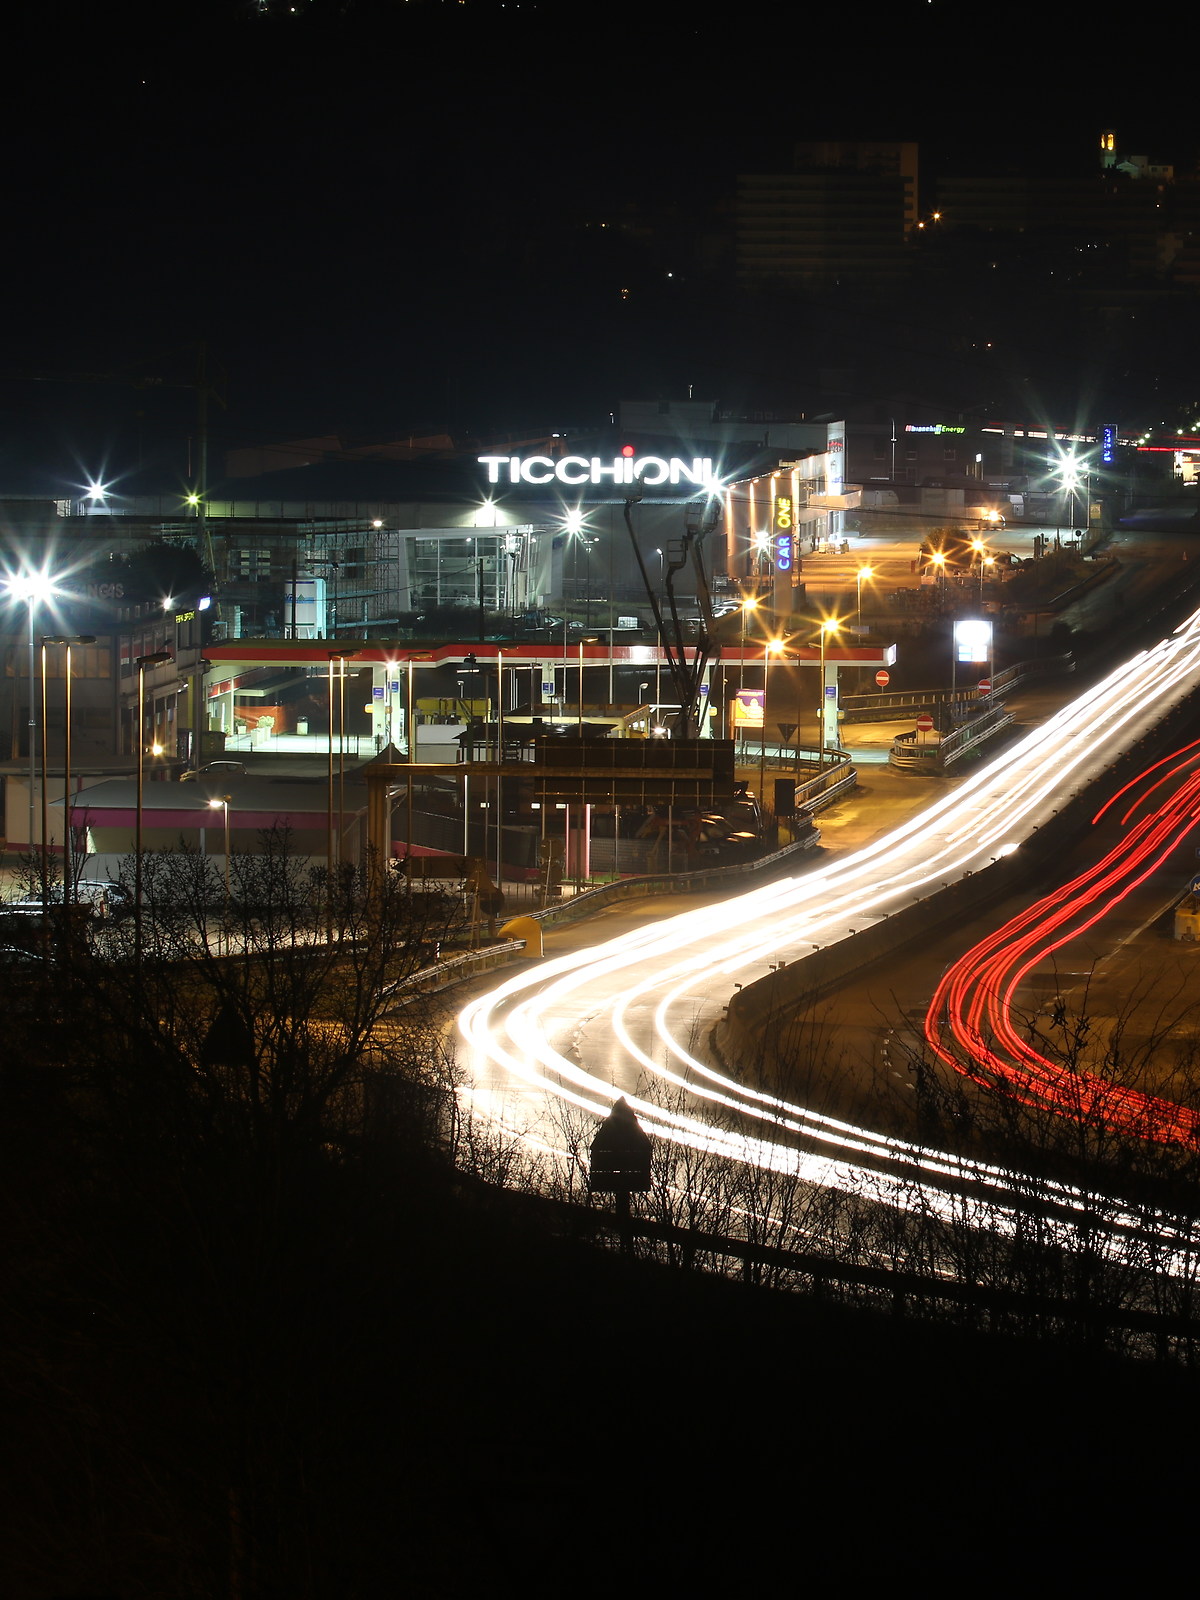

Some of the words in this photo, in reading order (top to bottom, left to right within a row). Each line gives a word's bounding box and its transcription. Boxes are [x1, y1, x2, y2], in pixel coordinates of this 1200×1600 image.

[942, 425, 965, 433] Energy
[777, 497, 791, 528] ONE
[778, 536, 790, 570] CAR
